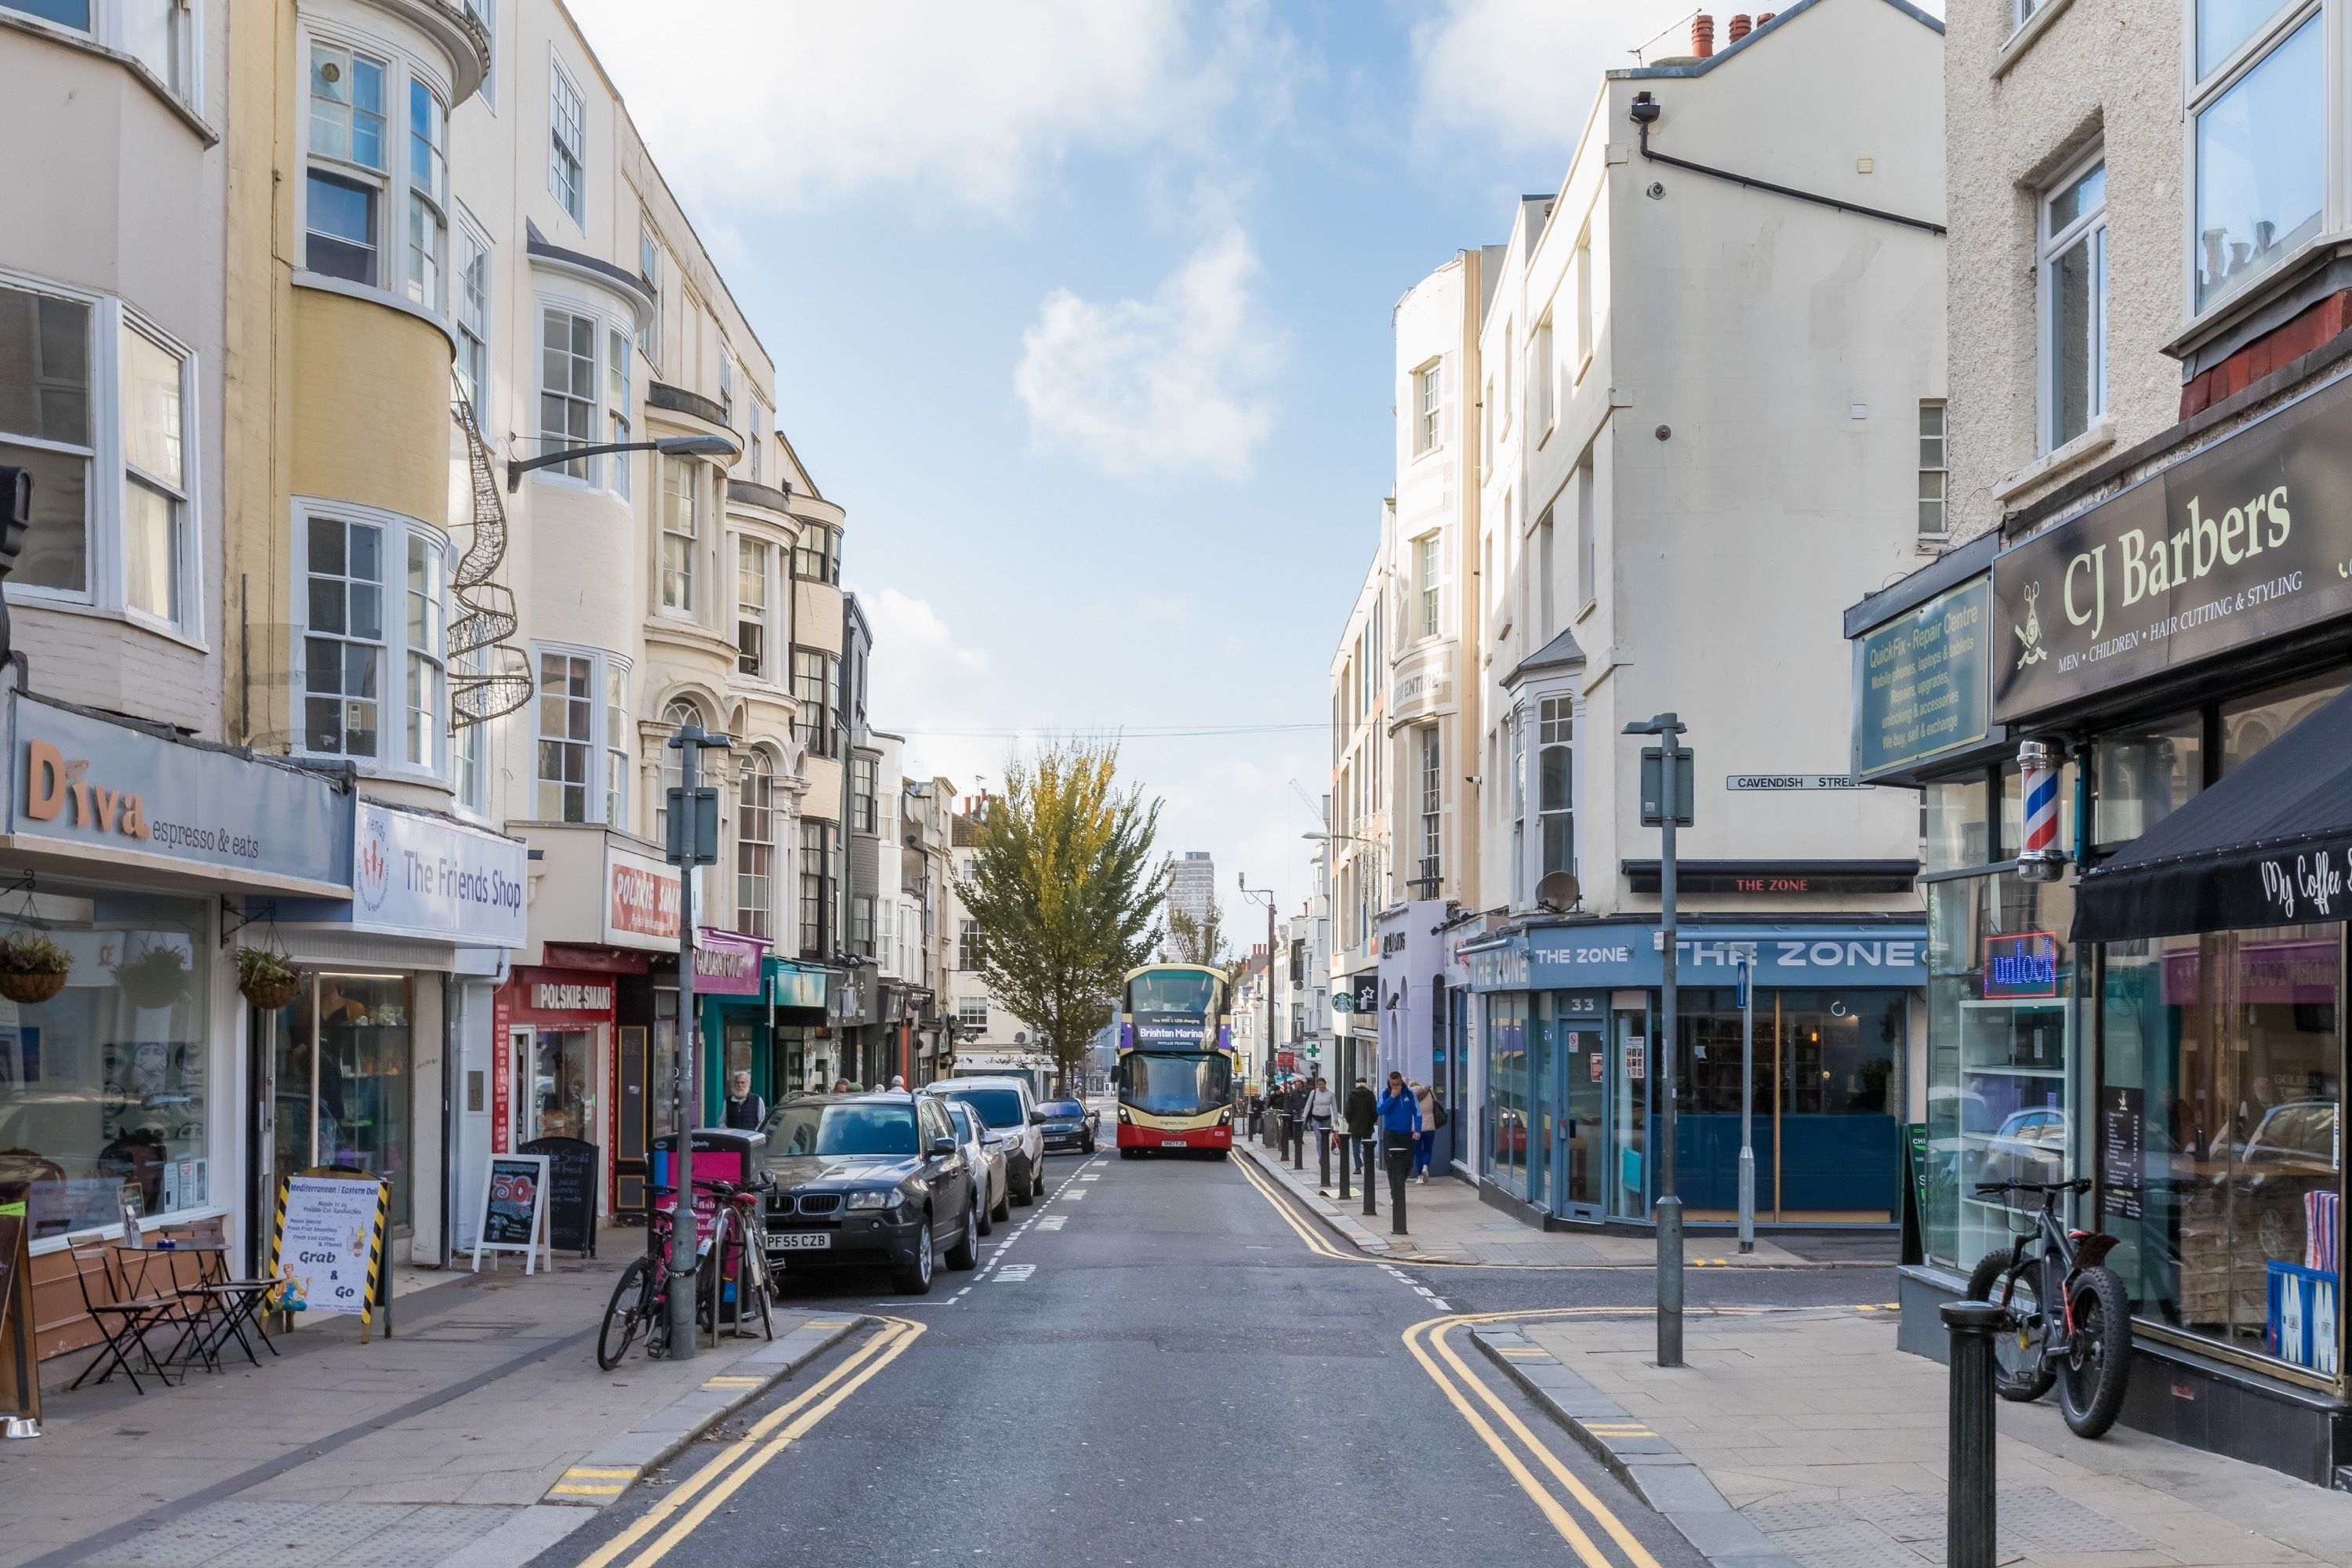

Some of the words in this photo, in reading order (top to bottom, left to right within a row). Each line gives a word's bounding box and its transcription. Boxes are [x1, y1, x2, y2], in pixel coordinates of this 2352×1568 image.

[2063, 543, 2107, 640] CJ
[2118, 485, 2291, 608] Barbers
[1870, 637, 1906, 669] QuickFix
[1913, 622, 1942, 650] Repair
[1944, 605, 1978, 635] Centre
[2058, 652, 2079, 673] MEN
[2089, 630, 2139, 662] CHILDREN
[2150, 616, 2178, 641] HAIR
[2180, 595, 2233, 630] CUTTING
[2234, 592, 2245, 610] &
[2248, 571, 2303, 607] STYLING
[1871, 670, 1891, 690] Mobile
[1918, 650, 1941, 672] laptops
[1943, 644, 1948, 660] &
[1949, 636, 1974, 657] tablets
[1882, 706, 1913, 729] unlocking
[1914, 702, 1918, 717] &
[1919, 690, 1959, 716] accessories
[1883, 734, 1893, 750] We
[1908, 725, 1919, 742] sell
[1921, 723, 1926, 738] &
[1926, 714, 1958, 735] exchange
[29, 739, 151, 840] Diva
[1737, 777, 1803, 788] CAVENDISH
[153, 820, 214, 851] espresso
[218, 828, 230, 853] &
[233, 834, 259, 858] eats
[404, 849, 434, 895] The
[438, 858, 488, 904] Friends
[492, 869, 521, 917] Shop
[617, 873, 655, 911] POLSKIE
[1737, 879, 1764, 891] THE
[1769, 879, 1808, 891] ZONE
[2261, 861, 2295, 918] My
[2297, 851, 2341, 916] Coffee
[1472, 953, 1490, 986] THE
[1496, 949, 1528, 985] ZONE
[1536, 949, 1570, 964] THE
[1576, 946, 1628, 964] ZONE
[1777, 941, 1915, 966] ZONE
[1994, 937, 2056, 985] unlock
[540, 983, 582, 1010] POLSKIE
[583, 985, 611, 1010] SMAKI
[1571, 998, 1595, 1011] 33
[1140, 1028, 1174, 1038] Brighton
[1175, 1028, 1203, 1038] Marina
[1206, 1028, 1212, 1039] 7
[290, 1183, 336, 1193] Mediterranean
[341, 1186, 365, 1195] Eastern
[366, 1187, 379, 1196] Deli
[699, 1201, 716, 1210] fish
[767, 1236, 798, 1248] PF55
[801, 1235, 826, 1247] CZB
[299, 1251, 336, 1264] Grab
[330, 1270, 339, 1280] &
[335, 1286, 355, 1299] Go
